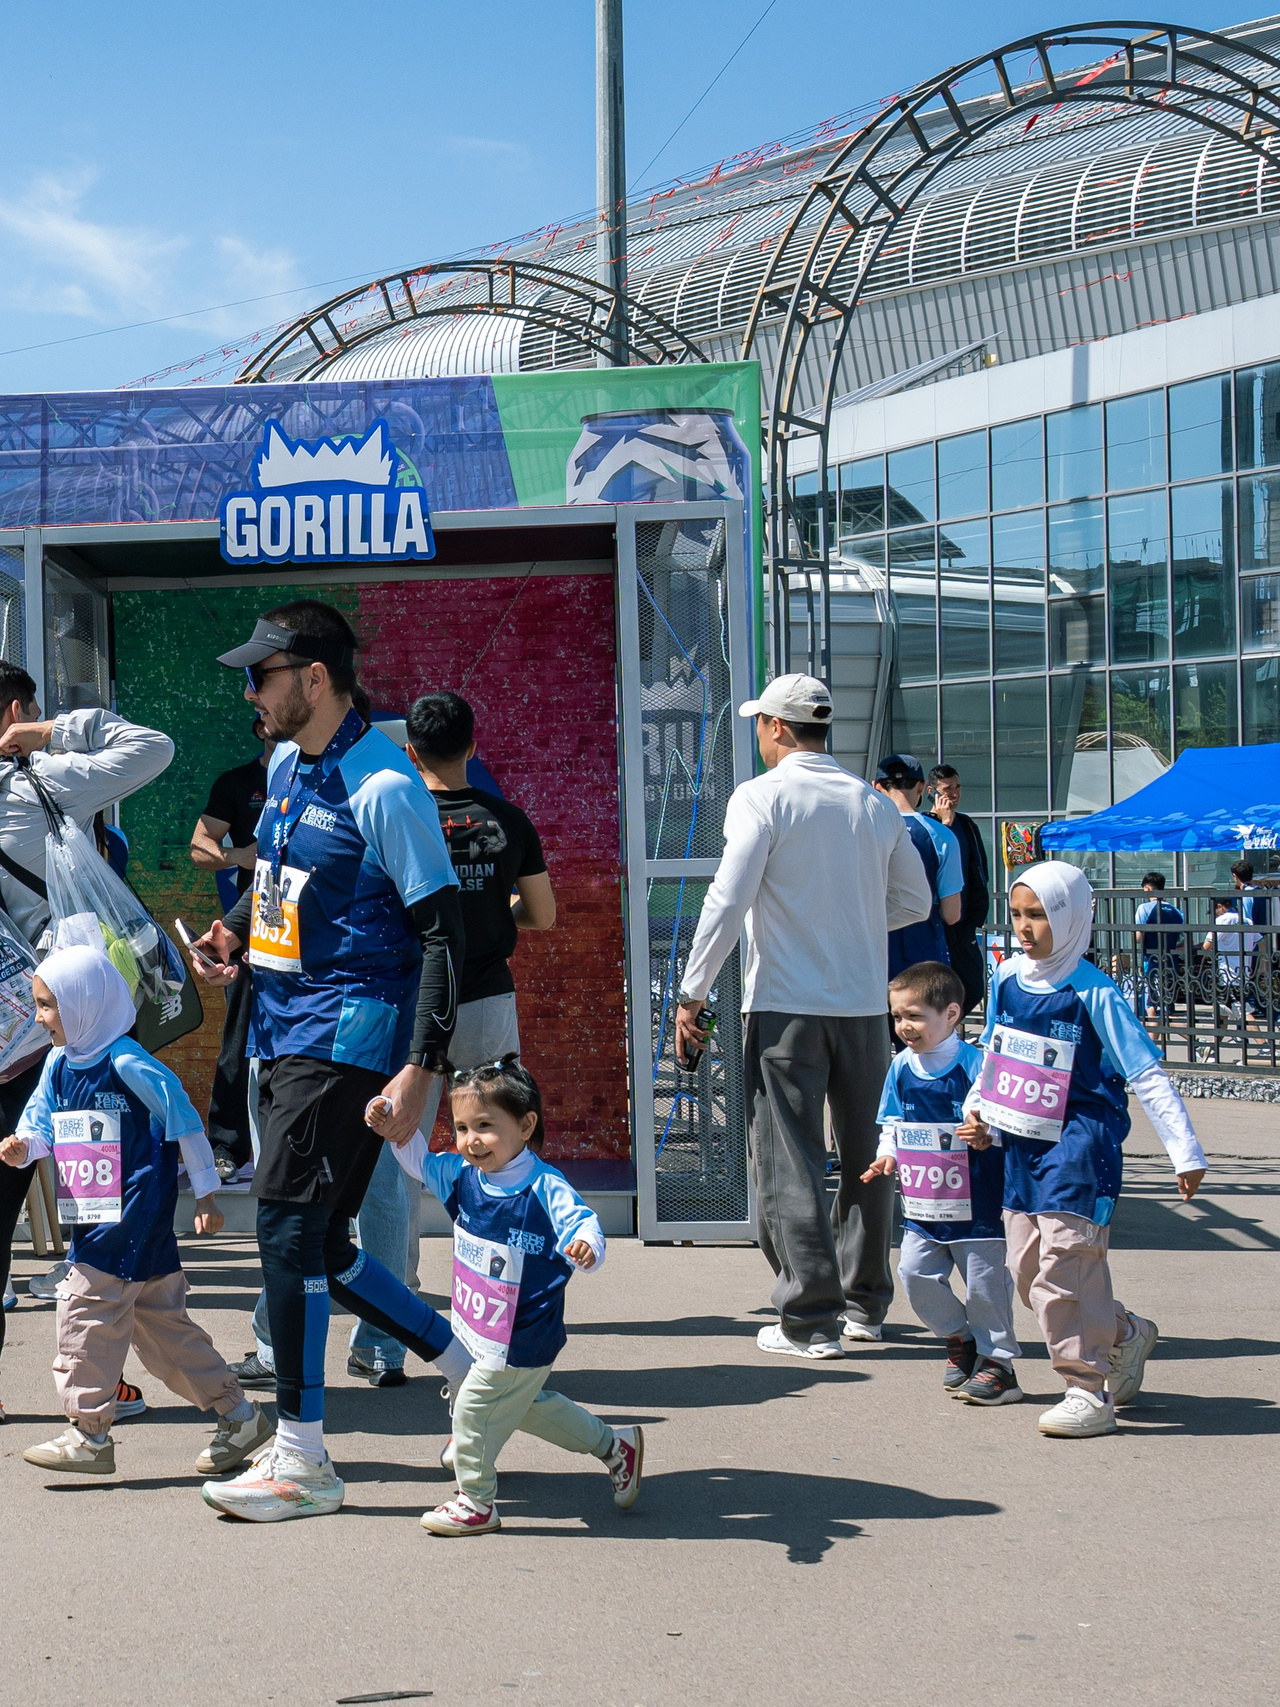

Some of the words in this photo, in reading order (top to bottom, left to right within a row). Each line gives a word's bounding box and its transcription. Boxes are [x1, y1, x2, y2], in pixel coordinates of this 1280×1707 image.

[227, 491, 429, 559] GORILLA
[997, 1071, 1060, 1108] 8795
[900, 1163, 963, 1190] 8796
[455, 1275, 508, 1328] 8797
